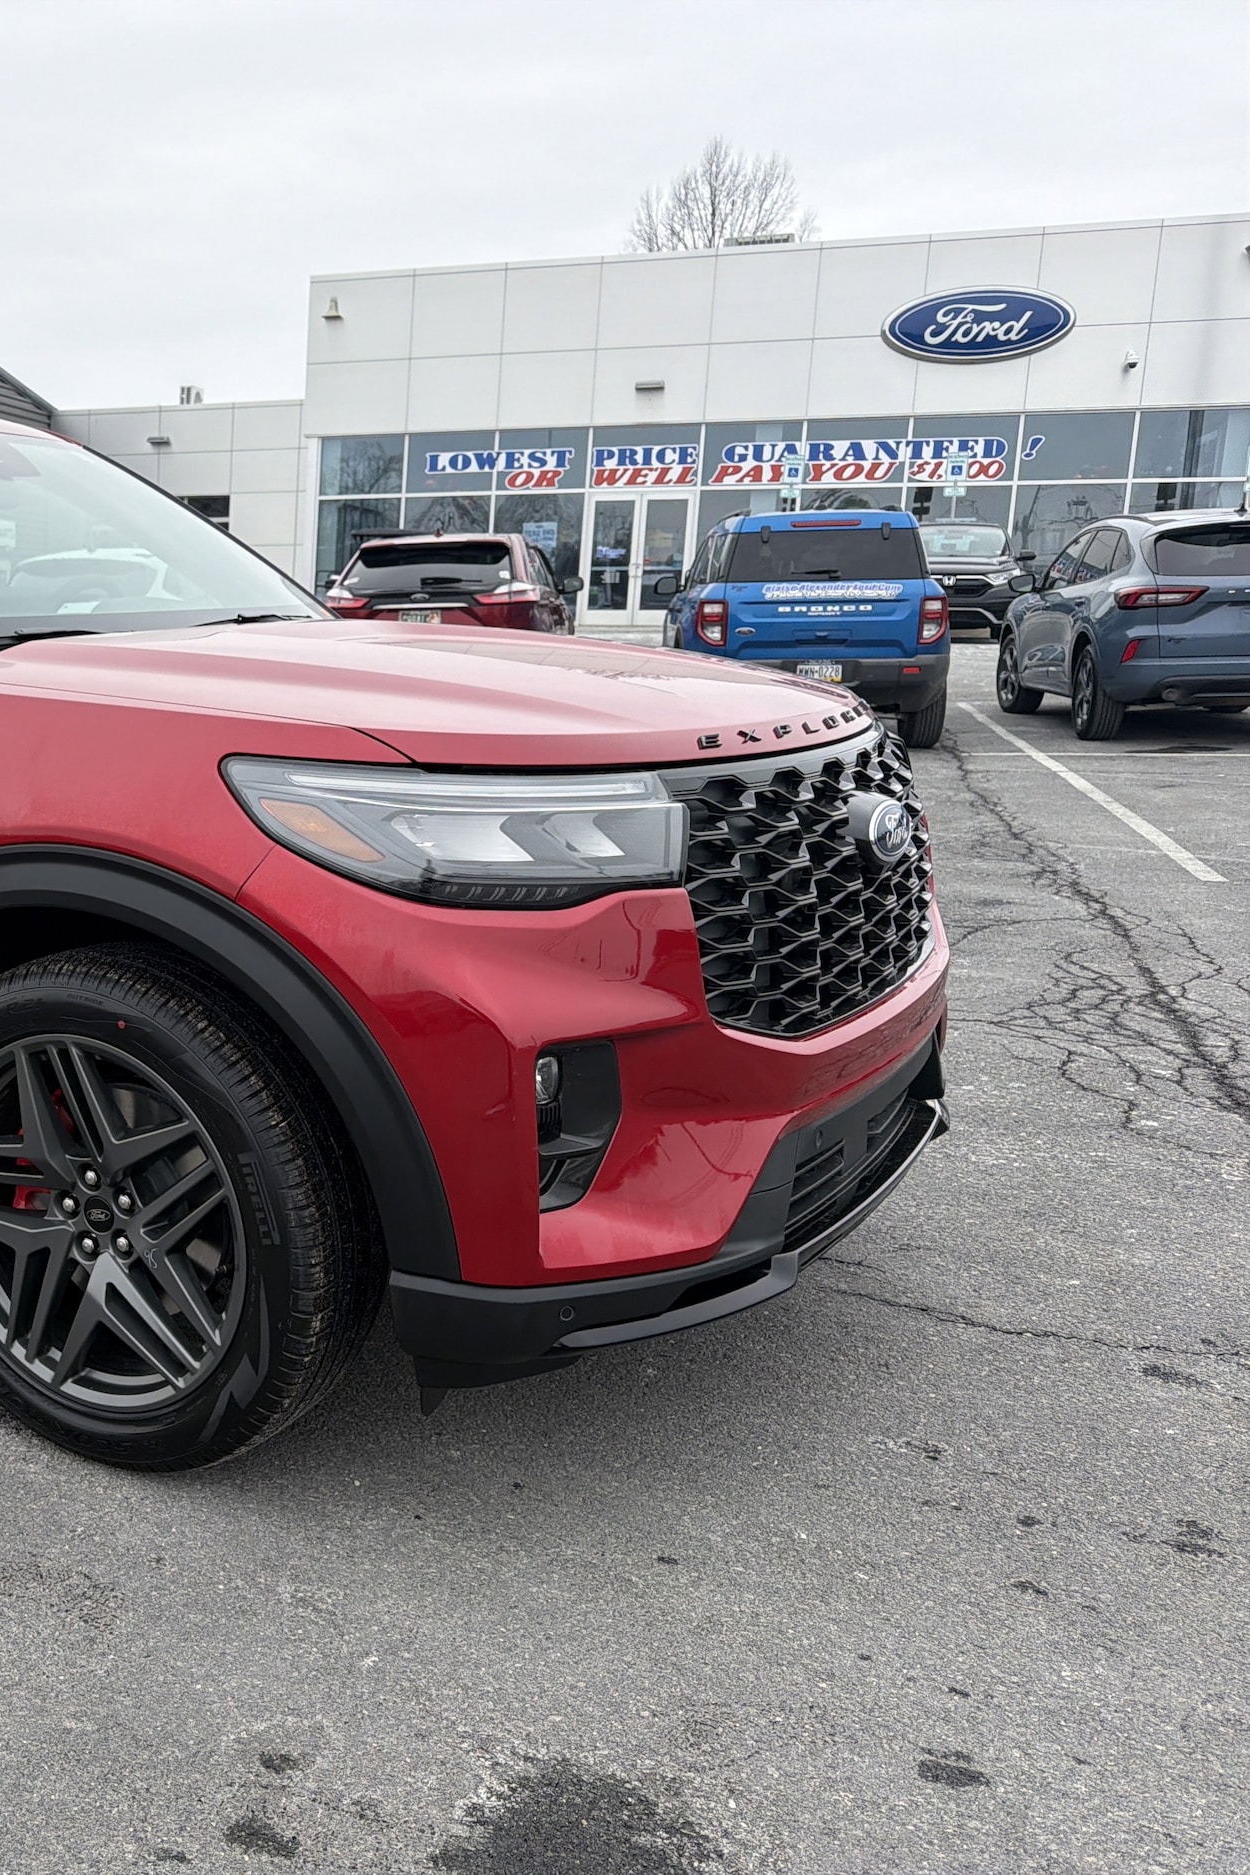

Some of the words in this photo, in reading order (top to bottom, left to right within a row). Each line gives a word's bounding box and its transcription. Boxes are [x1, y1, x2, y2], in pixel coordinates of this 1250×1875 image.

[924, 303, 1033, 345] Ford
[428, 449, 573, 472] LOWEST
[594, 446, 697, 467] PRICE
[723, 439, 1006, 463] GUARANTEED
[506, 470, 562, 488] OR
[594, 466, 695, 486] WE'LL
[711, 463, 784, 483] PAY
[808, 462, 897, 482] YOU
[909, 460, 1004, 480] $1,00
[777, 604, 872, 613] BRONCO
[884, 812, 908, 849] Ford
[238, 1152, 280, 1245] PIRELLI
